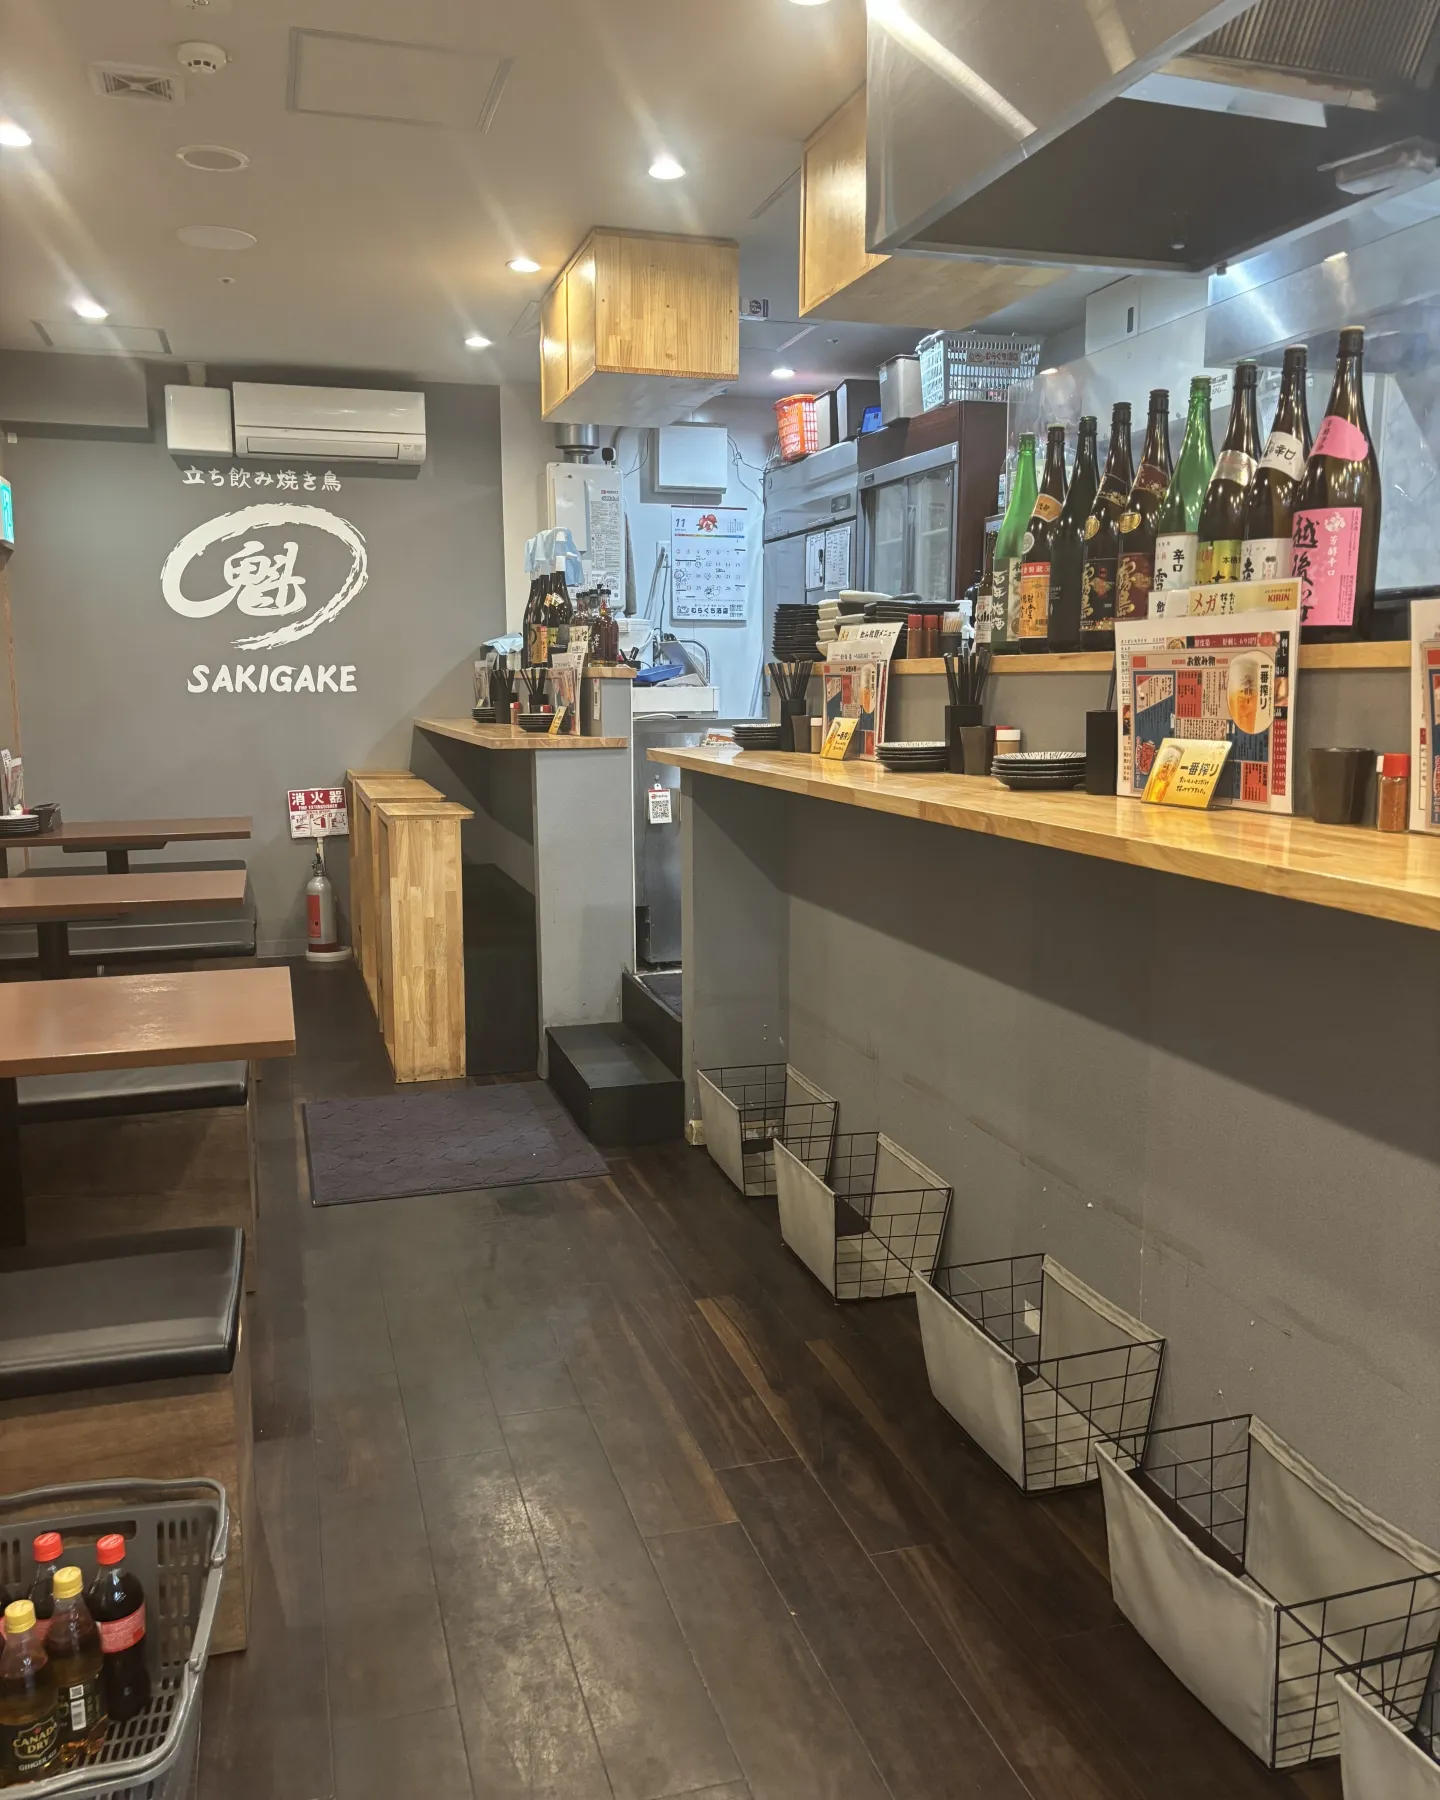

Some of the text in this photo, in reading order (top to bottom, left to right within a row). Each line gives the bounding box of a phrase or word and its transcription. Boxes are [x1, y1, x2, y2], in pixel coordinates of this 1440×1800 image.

[1274, 444, 1296, 460] 辛口
[182, 465, 342, 492] 立ち飲み焼き鳥
[1172, 548, 1185, 573] 辛口
[1268, 594, 1290, 603] KIRIN
[187, 664, 358, 693] SAKIGAKE
[1260, 664, 1270, 710] 一番搾り
[1180, 762, 1220, 778] 一番搾り
[291, 790, 343, 806] 消火器
[27, 1739, 50, 1754] DRY
